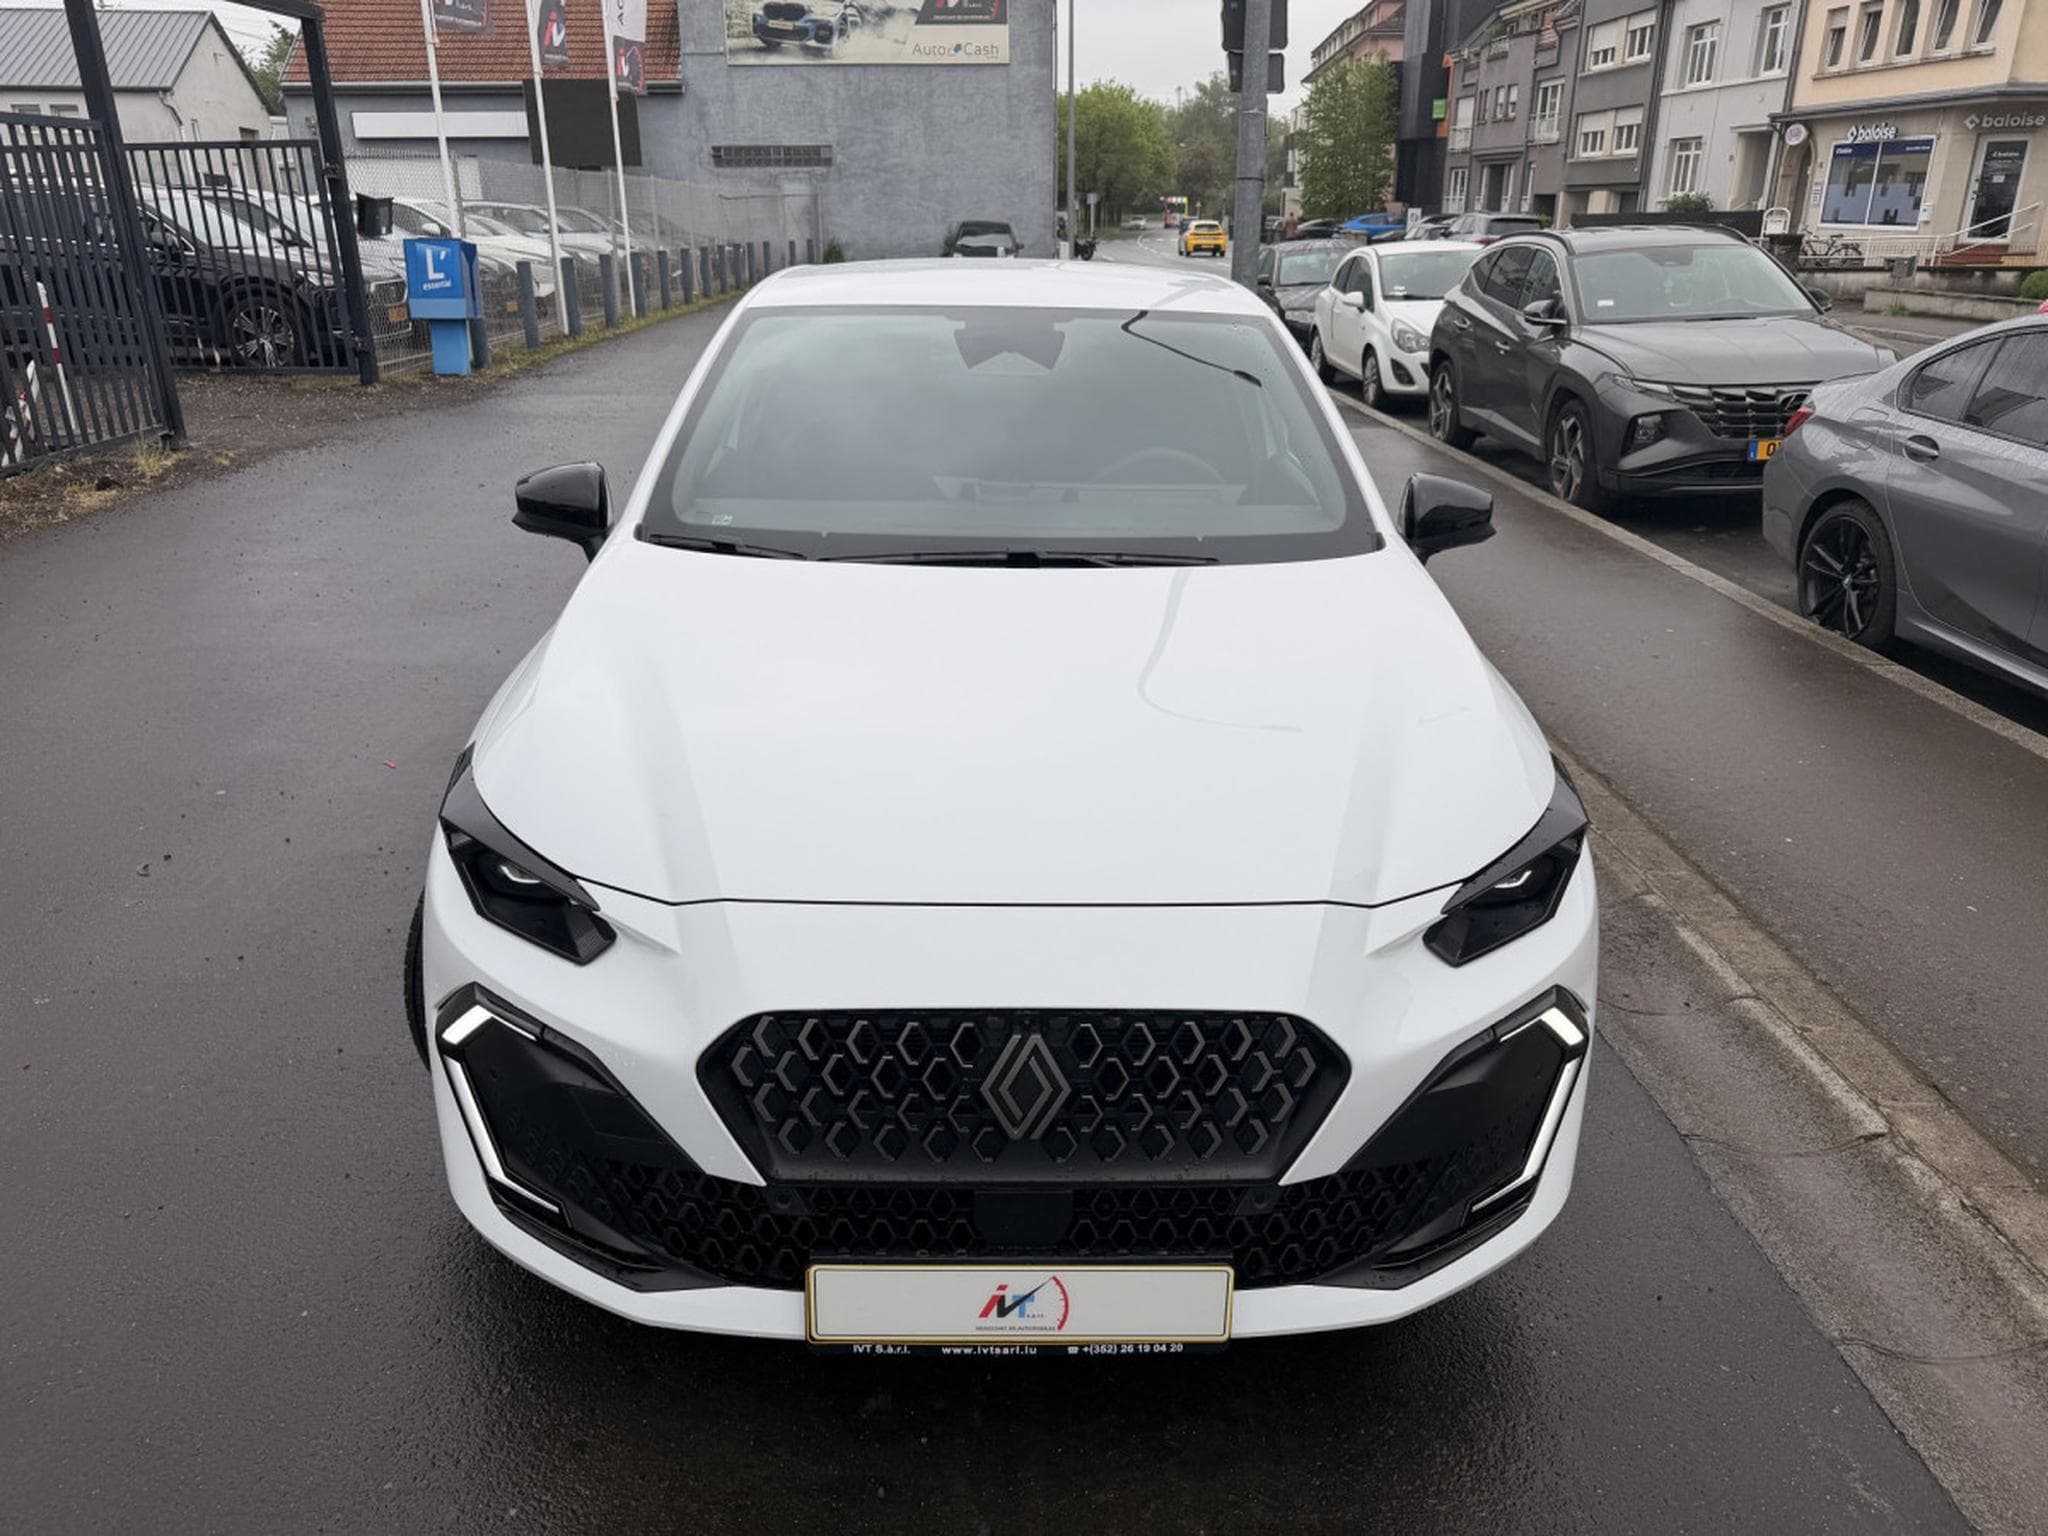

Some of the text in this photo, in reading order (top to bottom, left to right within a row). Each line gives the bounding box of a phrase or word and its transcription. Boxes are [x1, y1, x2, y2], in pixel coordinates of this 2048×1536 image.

[912, 42, 999, 56] Auto Cash
[1981, 112, 2046, 127] baloise
[1858, 123, 1896, 140] baloise
[853, 1344, 872, 1354] IVT
[1081, 1344, 1118, 1355] +(352)
[1153, 1343, 1167, 1353] 04
[1169, 1343, 1184, 1353] 20
